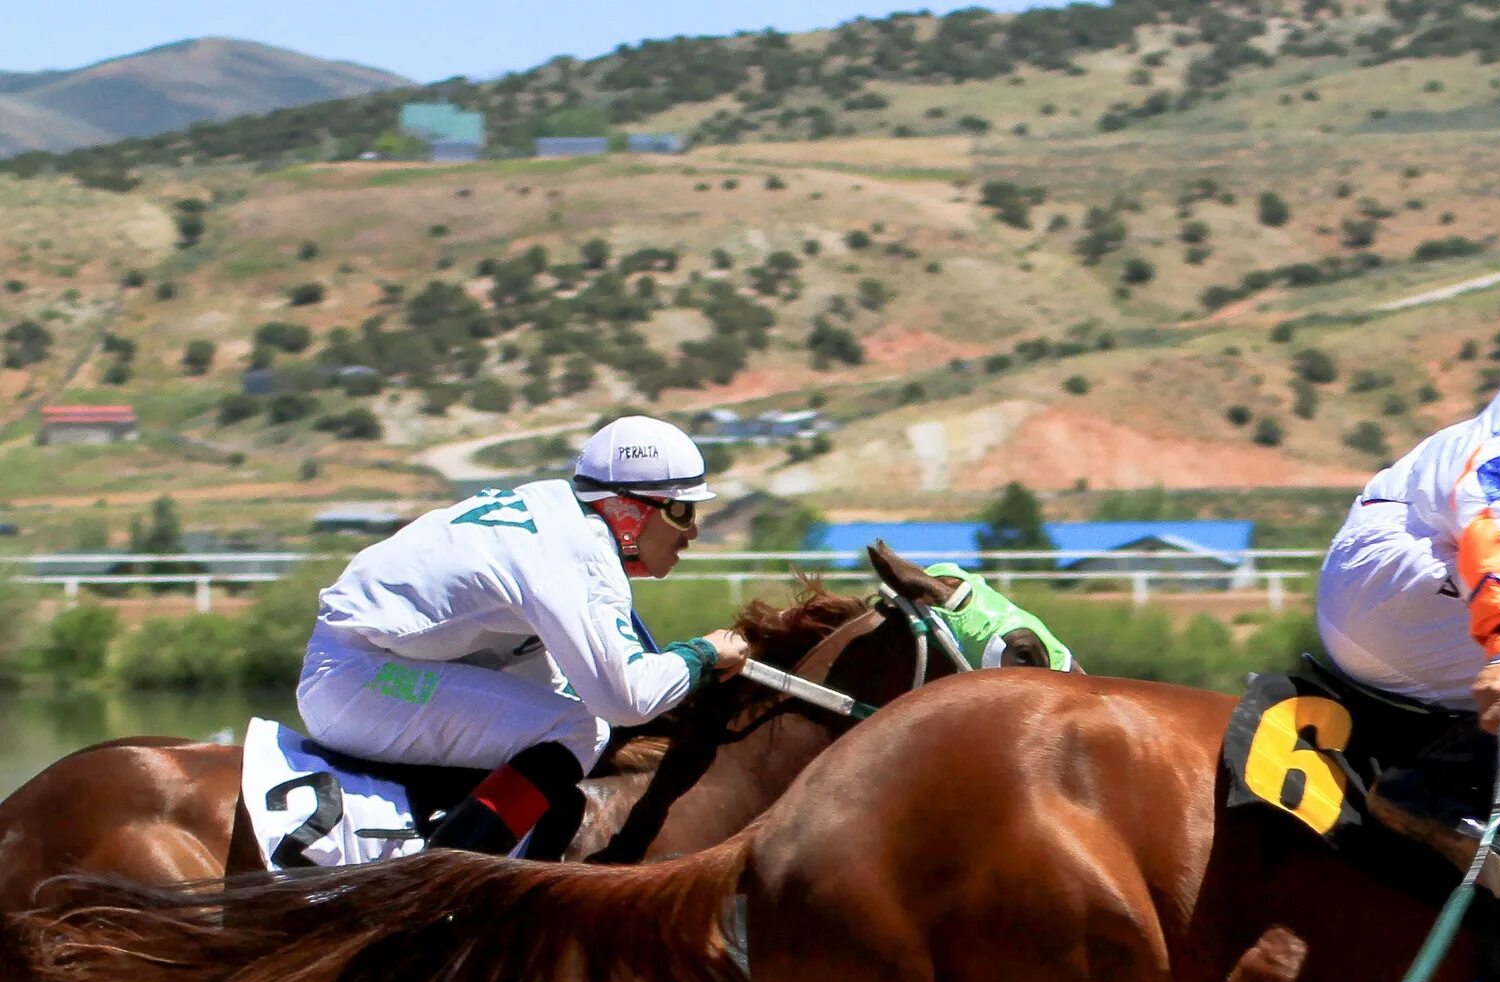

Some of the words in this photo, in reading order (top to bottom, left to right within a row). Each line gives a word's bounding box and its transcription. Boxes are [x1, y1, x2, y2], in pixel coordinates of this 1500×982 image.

[618, 445, 659, 460] PERALTA
[1244, 695, 1353, 835] 6
[265, 771, 344, 868] 2
